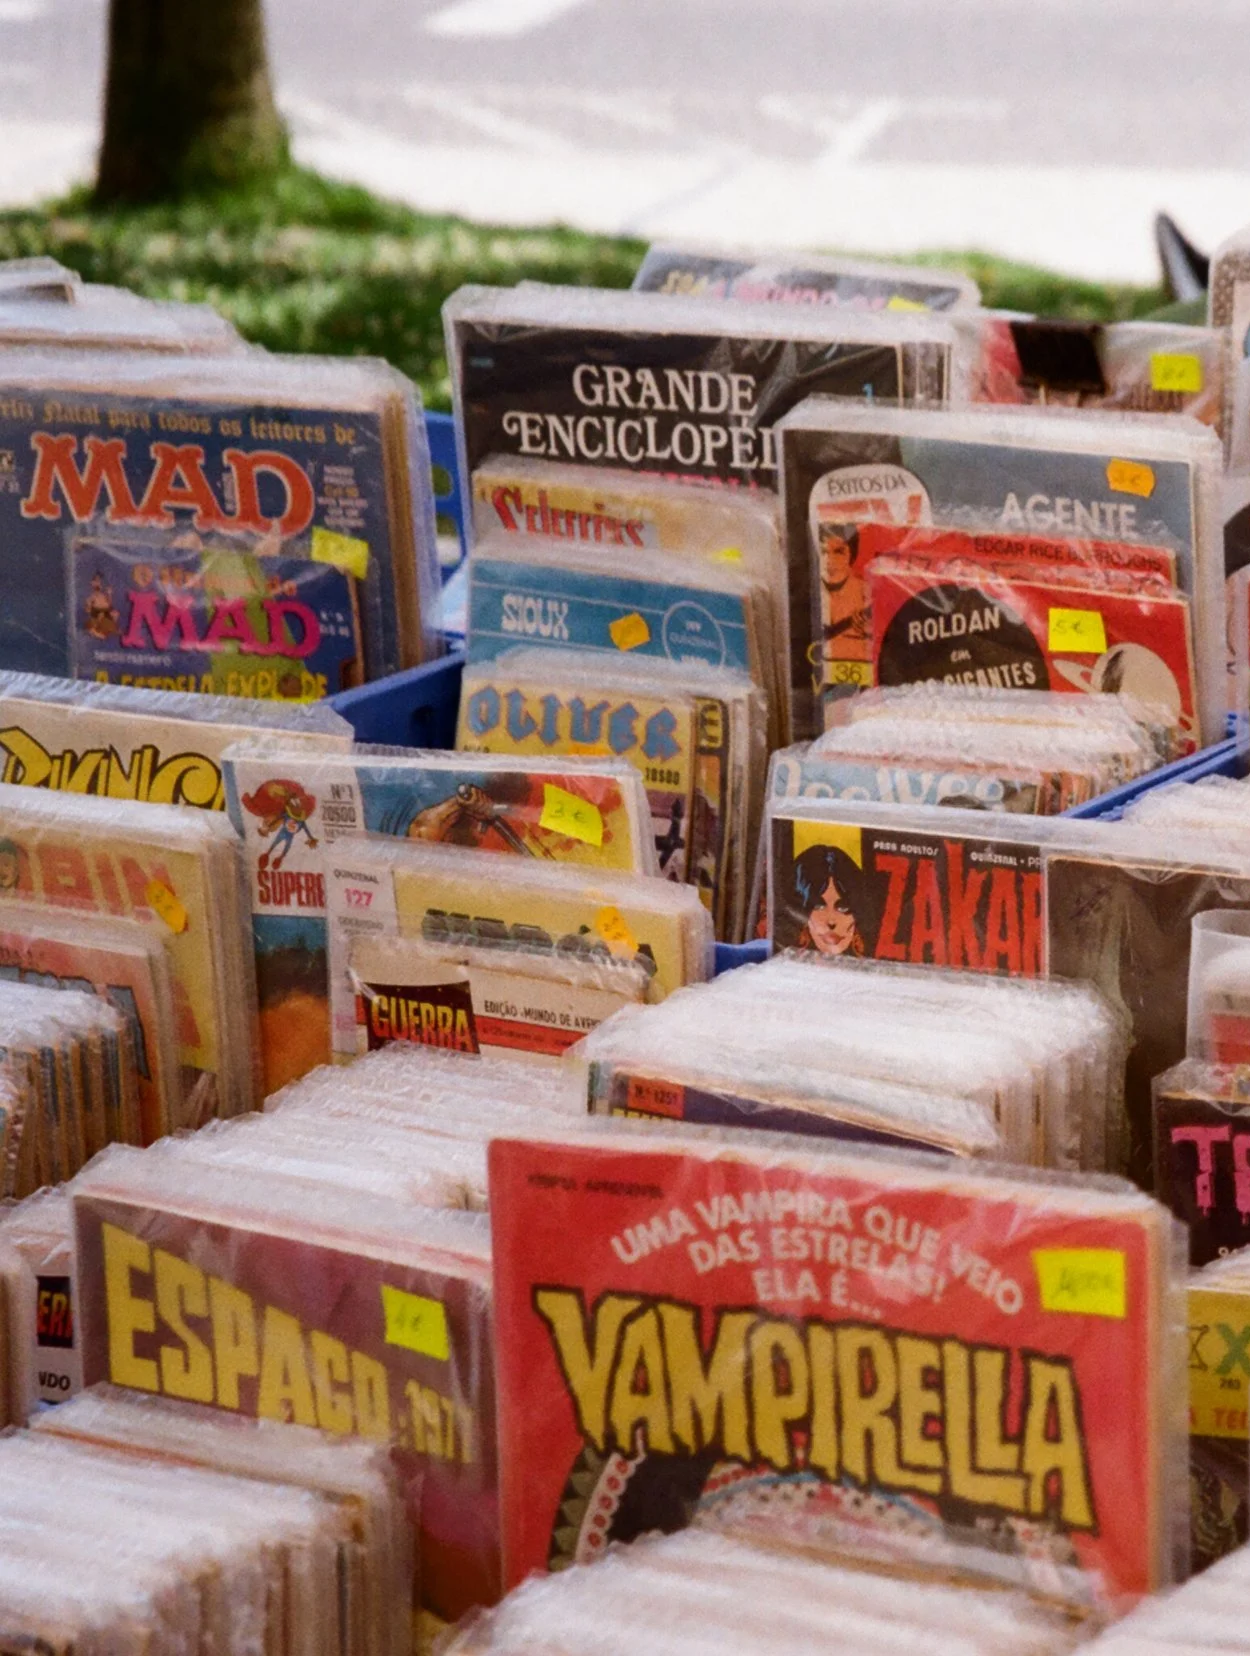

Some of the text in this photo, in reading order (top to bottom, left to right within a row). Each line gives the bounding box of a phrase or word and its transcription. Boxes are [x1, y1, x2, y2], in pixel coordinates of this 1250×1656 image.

[573, 364, 758, 416] GRANDE
[20, 431, 316, 541] MAD
[1000, 491, 1138, 540] AGENTE
[973, 537, 1026, 557] EDGAR
[1029, 542, 1064, 562] RICE
[120, 590, 322, 660] MAD
[501, 592, 569, 641] SIOUX
[908, 607, 1001, 644] ROLDAN
[834, 663, 863, 684] 36
[467, 683, 683, 763] OLIVER
[345, 887, 374, 907] 127
[370, 994, 477, 1055] GUERRA
[484, 999, 519, 1018] EDIÇÃO
[560, 1012, 573, 1026] DE
[611, 1209, 693, 1265] UMA
[695, 1190, 854, 1231] VAMPIRA
[864, 1203, 941, 1258] QUE
[950, 1242, 1024, 1316] VEIO
[687, 1226, 948, 1304] DAS ESTRELAS!
[751, 1268, 822, 1302] ELA
[532, 1282, 1102, 1537] VAMPIRELLA
